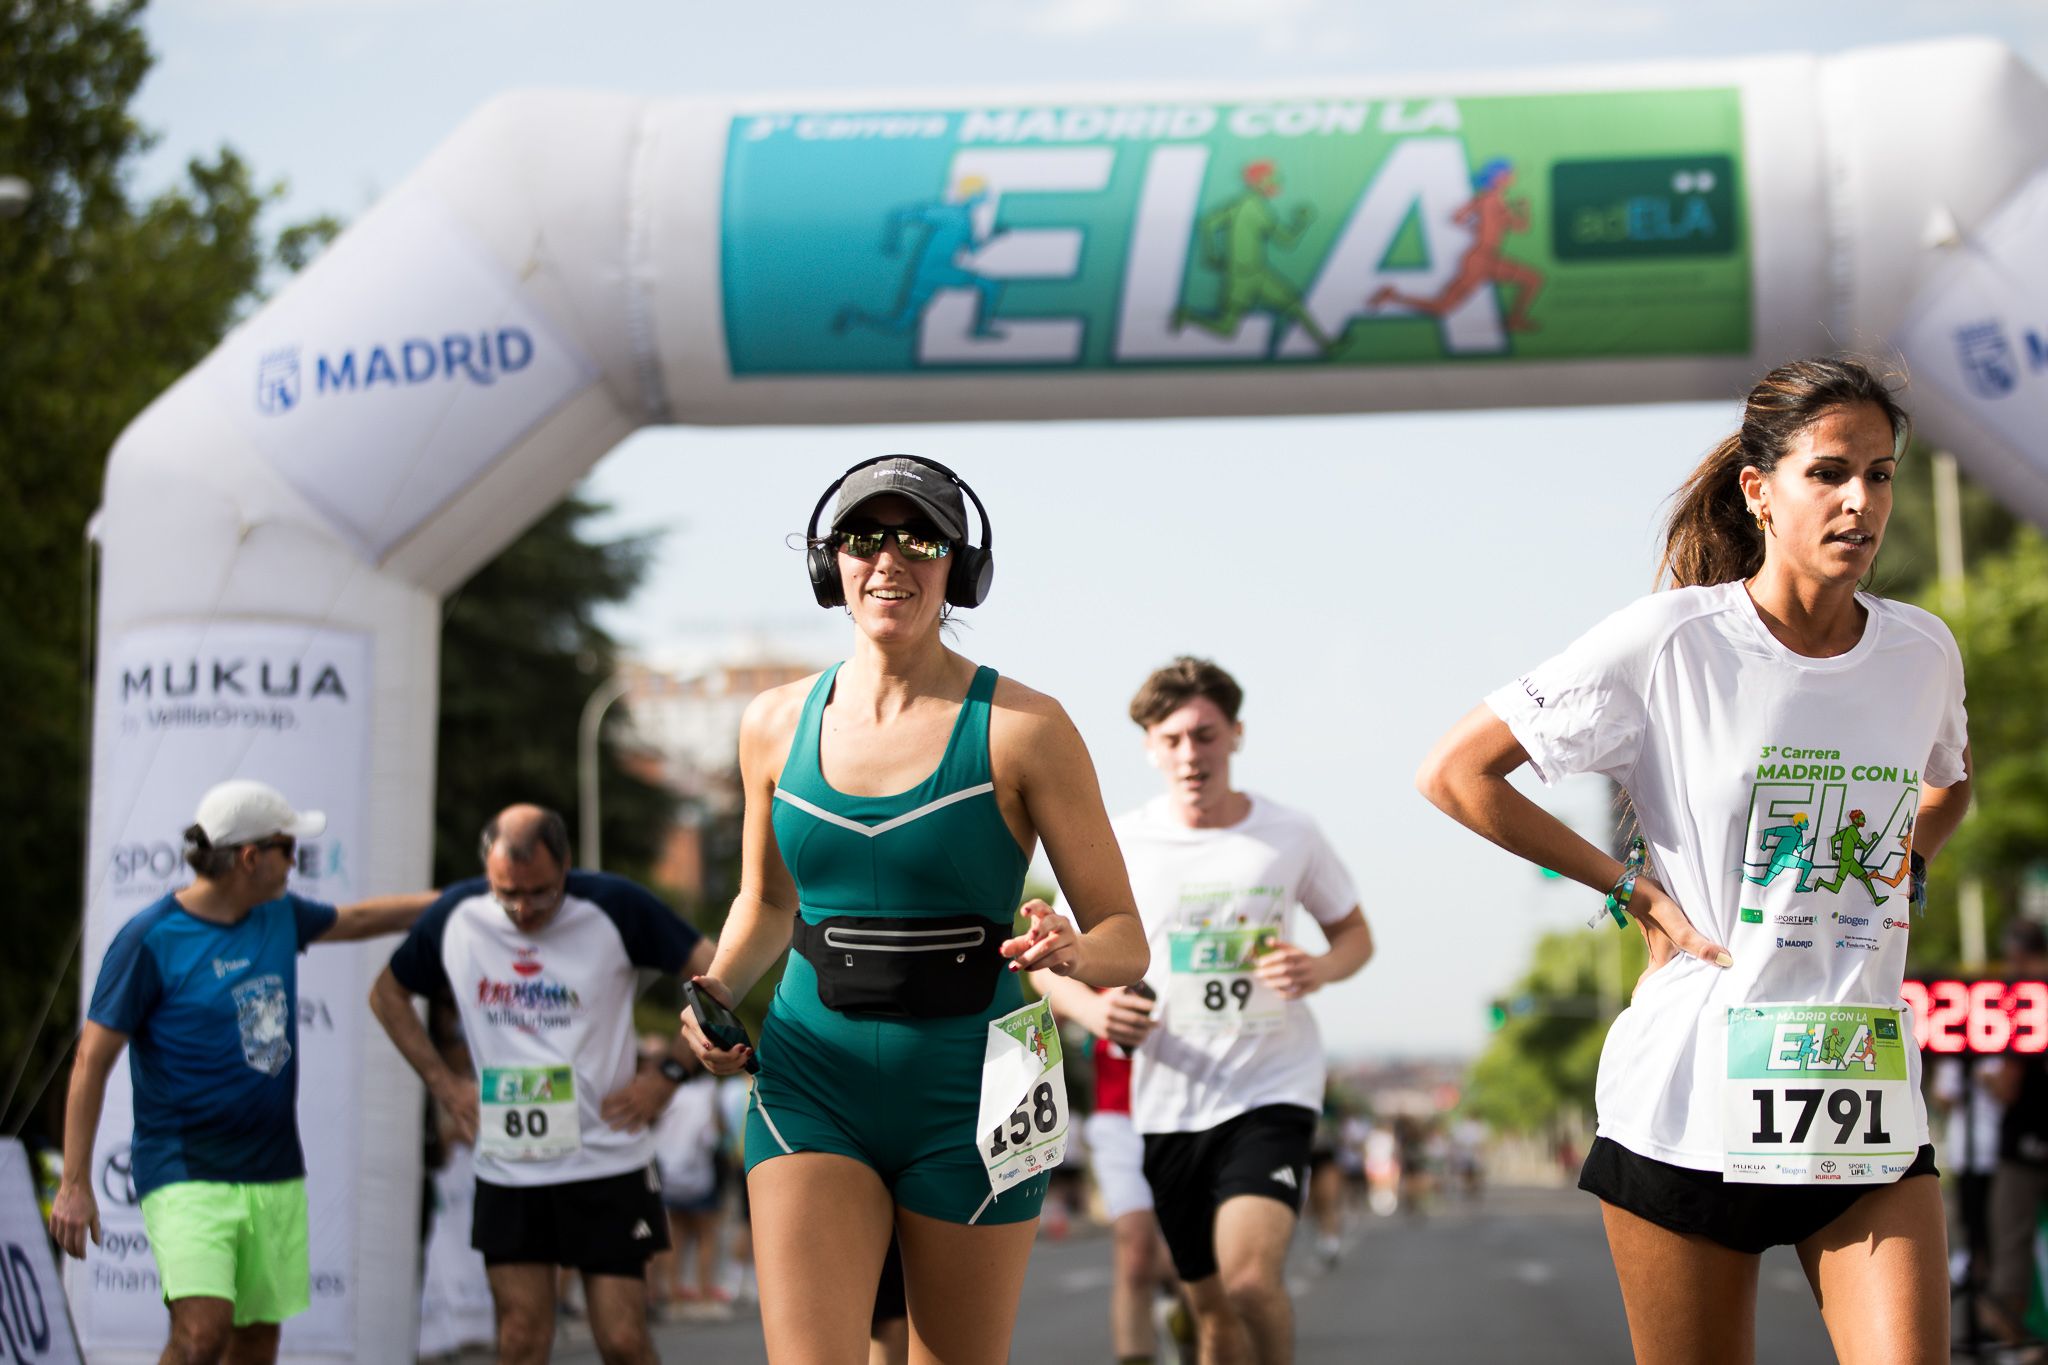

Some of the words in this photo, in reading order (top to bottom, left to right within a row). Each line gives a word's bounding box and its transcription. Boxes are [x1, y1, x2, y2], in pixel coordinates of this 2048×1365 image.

[798, 112, 949, 140] Carrera
[957, 107, 1219, 142] MADRID
[1227, 102, 1367, 136] CON
[1380, 99, 1462, 133] LA
[917, 138, 1508, 362] ELA
[314, 325, 537, 393] MADRID
[121, 658, 349, 702] MUKUA
[1760, 746, 1777, 759] 3ª
[1781, 746, 1841, 760] Carrera
[1756, 763, 1847, 781] MADRID
[1851, 765, 1898, 783] CON
[1902, 768, 1919, 786] LA
[1743, 783, 1919, 871] ELA
[1838, 914, 1869, 927] Biogen
[1784, 940, 1813, 948] MADRID
[1204, 977, 1253, 1012] 89
[1006, 1019, 1023, 1033] CON
[1023, 1014, 1034, 1026] LA
[1777, 1011, 1826, 1022] MADRID
[1830, 1011, 1854, 1022] CON
[1856, 1012, 1868, 1022] LA
[1767, 1023, 1876, 1071] ELA
[496, 1074, 553, 1099] ELA
[505, 1109, 548, 1138] 80
[1752, 1088, 1891, 1145] 1791
[1781, 1167, 1807, 1175] Biogen
[98, 1229, 149, 1257] Toyo
[96, 1265, 162, 1293] Finan
